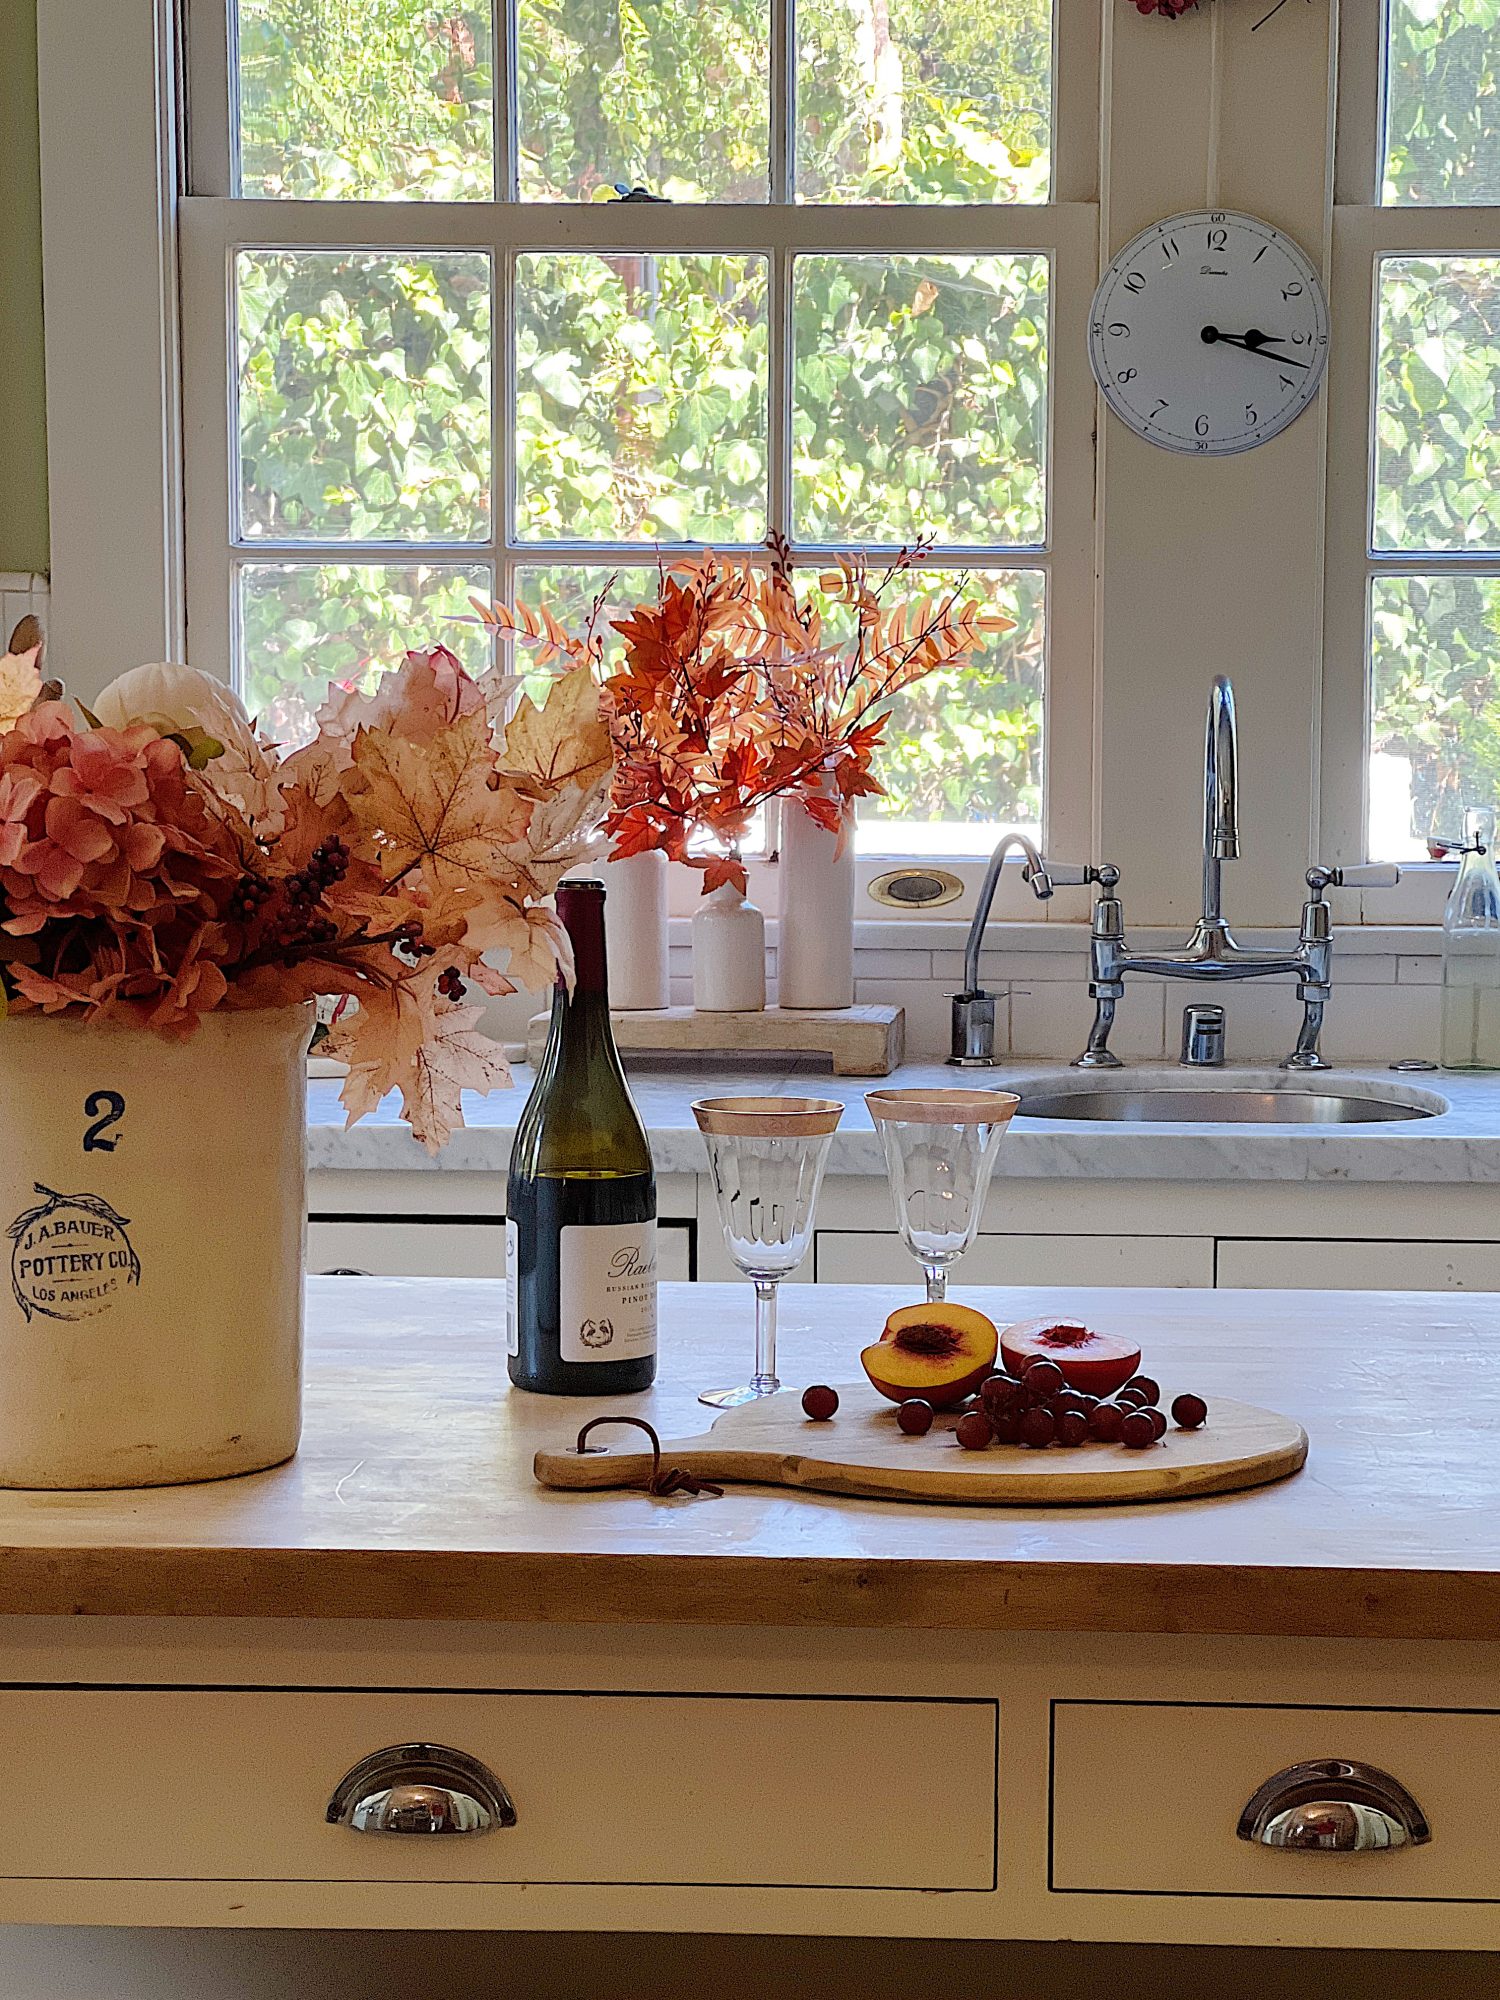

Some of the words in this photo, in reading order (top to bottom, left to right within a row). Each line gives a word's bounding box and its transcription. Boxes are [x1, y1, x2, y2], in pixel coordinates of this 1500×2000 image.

[1161, 238, 1180, 260] 11
[1207, 229, 1228, 252] 12
[1252, 245, 1269, 264] 1
[1123, 272, 1146, 294] 10
[1280, 281, 1303, 301] 2
[1107, 322, 1131, 338] 9
[1291, 329, 1312, 346] 3
[1117, 367, 1138, 384] 8
[1279, 374, 1295, 392] 4
[1149, 399, 1169, 418] 7
[1245, 403, 1258, 426] 5
[1194, 414, 1209, 436] 6
[83, 1090, 125, 1151] 2
[19, 1252, 104, 1279] POTTERY
[32, 1285, 55, 1301] LOS
[60, 1278, 118, 1303] ANGELES
[621, 1294, 648, 1304] PINOT
